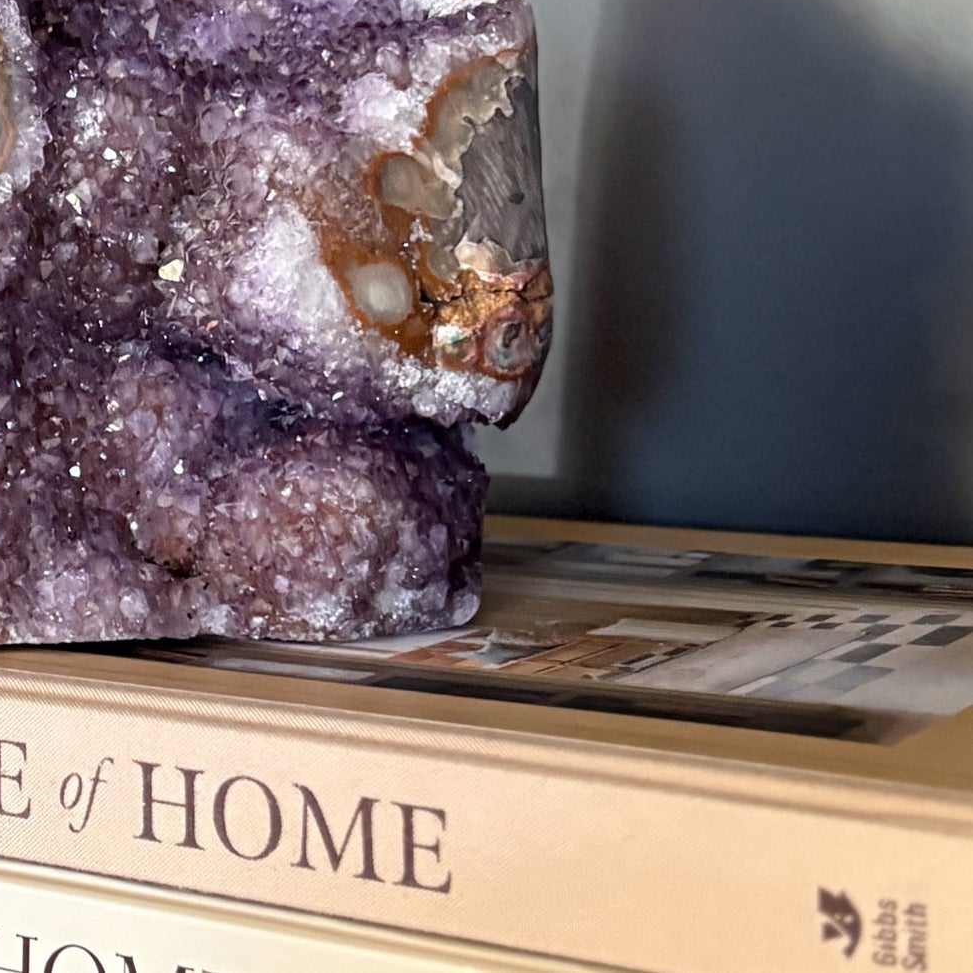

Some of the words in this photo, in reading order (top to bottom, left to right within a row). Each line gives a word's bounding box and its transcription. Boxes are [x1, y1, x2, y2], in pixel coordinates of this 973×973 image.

[59, 757, 114, 833] of
[132, 759, 453, 894] HOME
[872, 899, 898, 967] Gibbs
[901, 902, 928, 972] Smith
